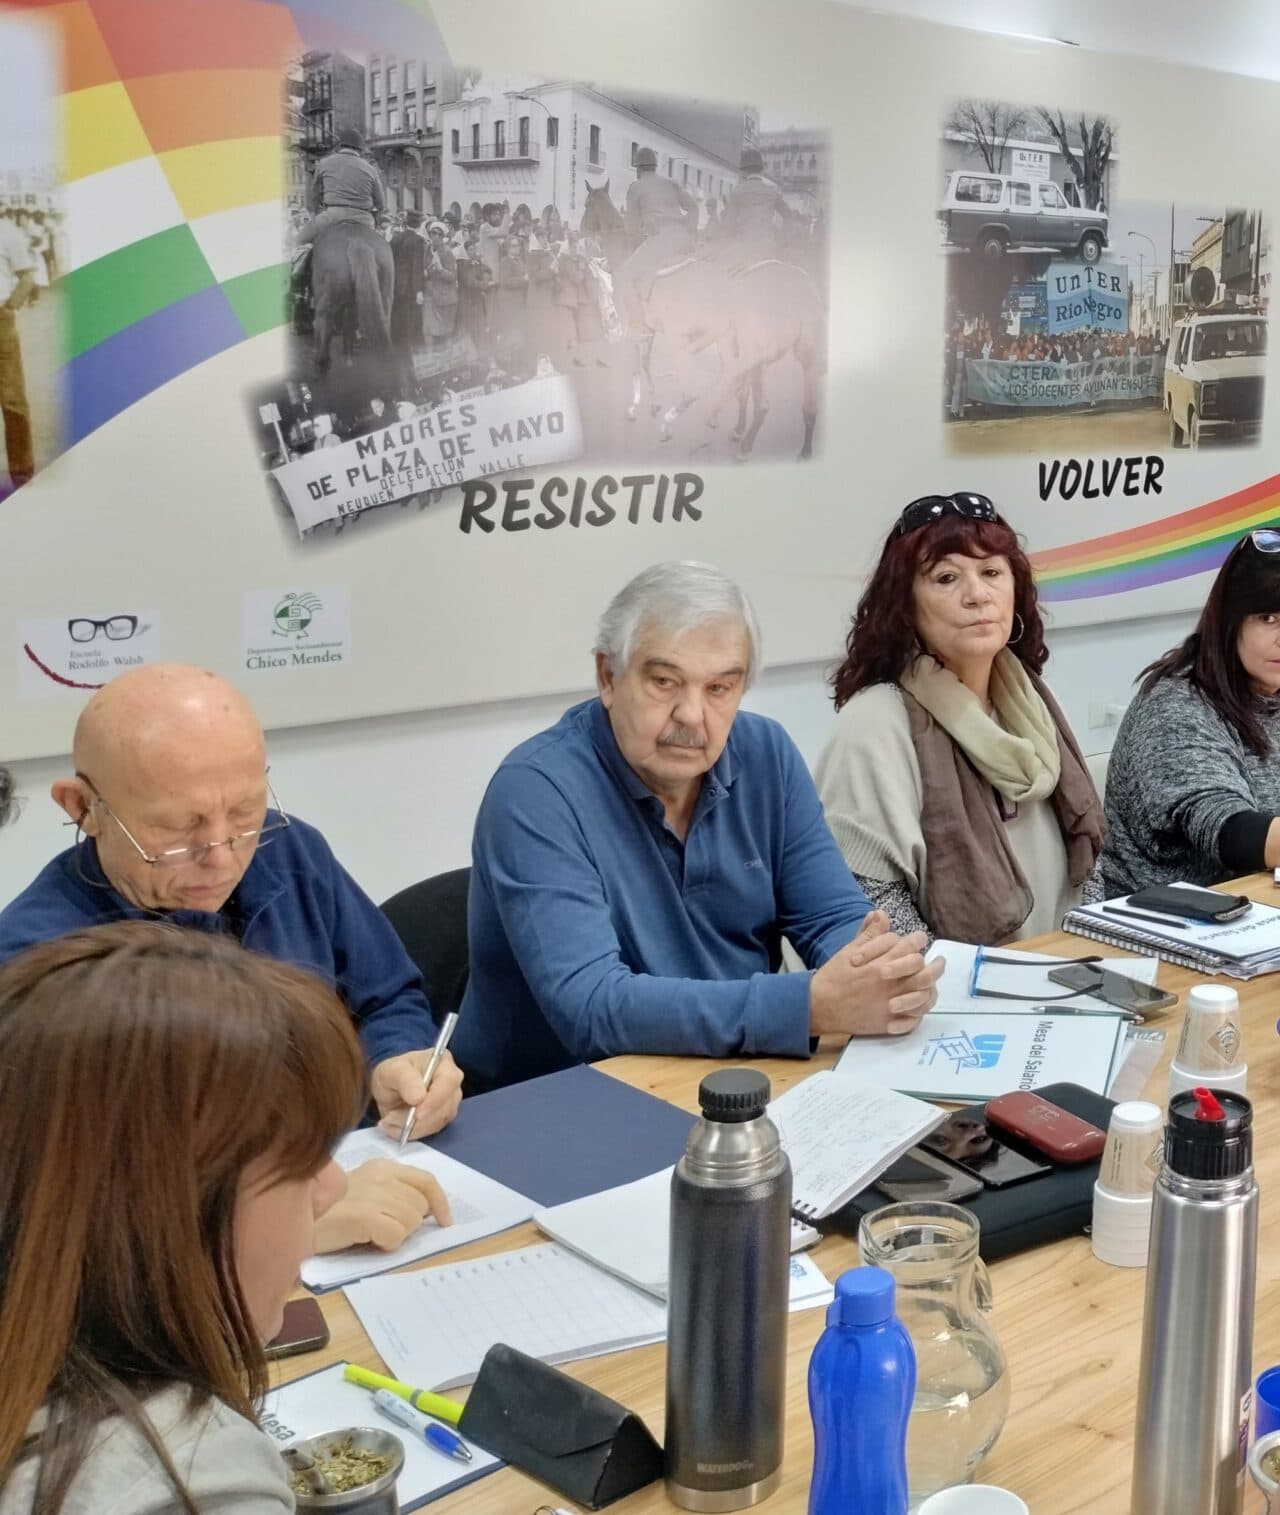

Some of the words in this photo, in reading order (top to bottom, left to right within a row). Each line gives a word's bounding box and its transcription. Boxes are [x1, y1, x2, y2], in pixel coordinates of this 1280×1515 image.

[1083, 296, 1122, 321] Negro
[1010, 366, 1060, 381] CTERA
[1009, 384, 1028, 397] LOS
[1031, 383, 1081, 397] DOCENTES
[357, 404, 477, 460] MADRES
[307, 475, 337, 500] DE
[346, 448, 427, 487] PLAZA
[439, 433, 475, 460] DE
[489, 411, 564, 448] MAYO
[407, 482, 414, 493] Y
[430, 471, 464, 489] ALTO
[480, 454, 526, 475] VALLE
[1039, 455, 1165, 501] VOLVER
[459, 473, 705, 534] RESISTIR
[246, 655, 287, 669] Chico
[291, 649, 343, 665] Mendes
[1033, 1020, 1054, 1043] Mesa
[1028, 1043, 1048, 1059] del
[1018, 1060, 1043, 1091] Salario
[258, 1408, 296, 1441] Mesa
